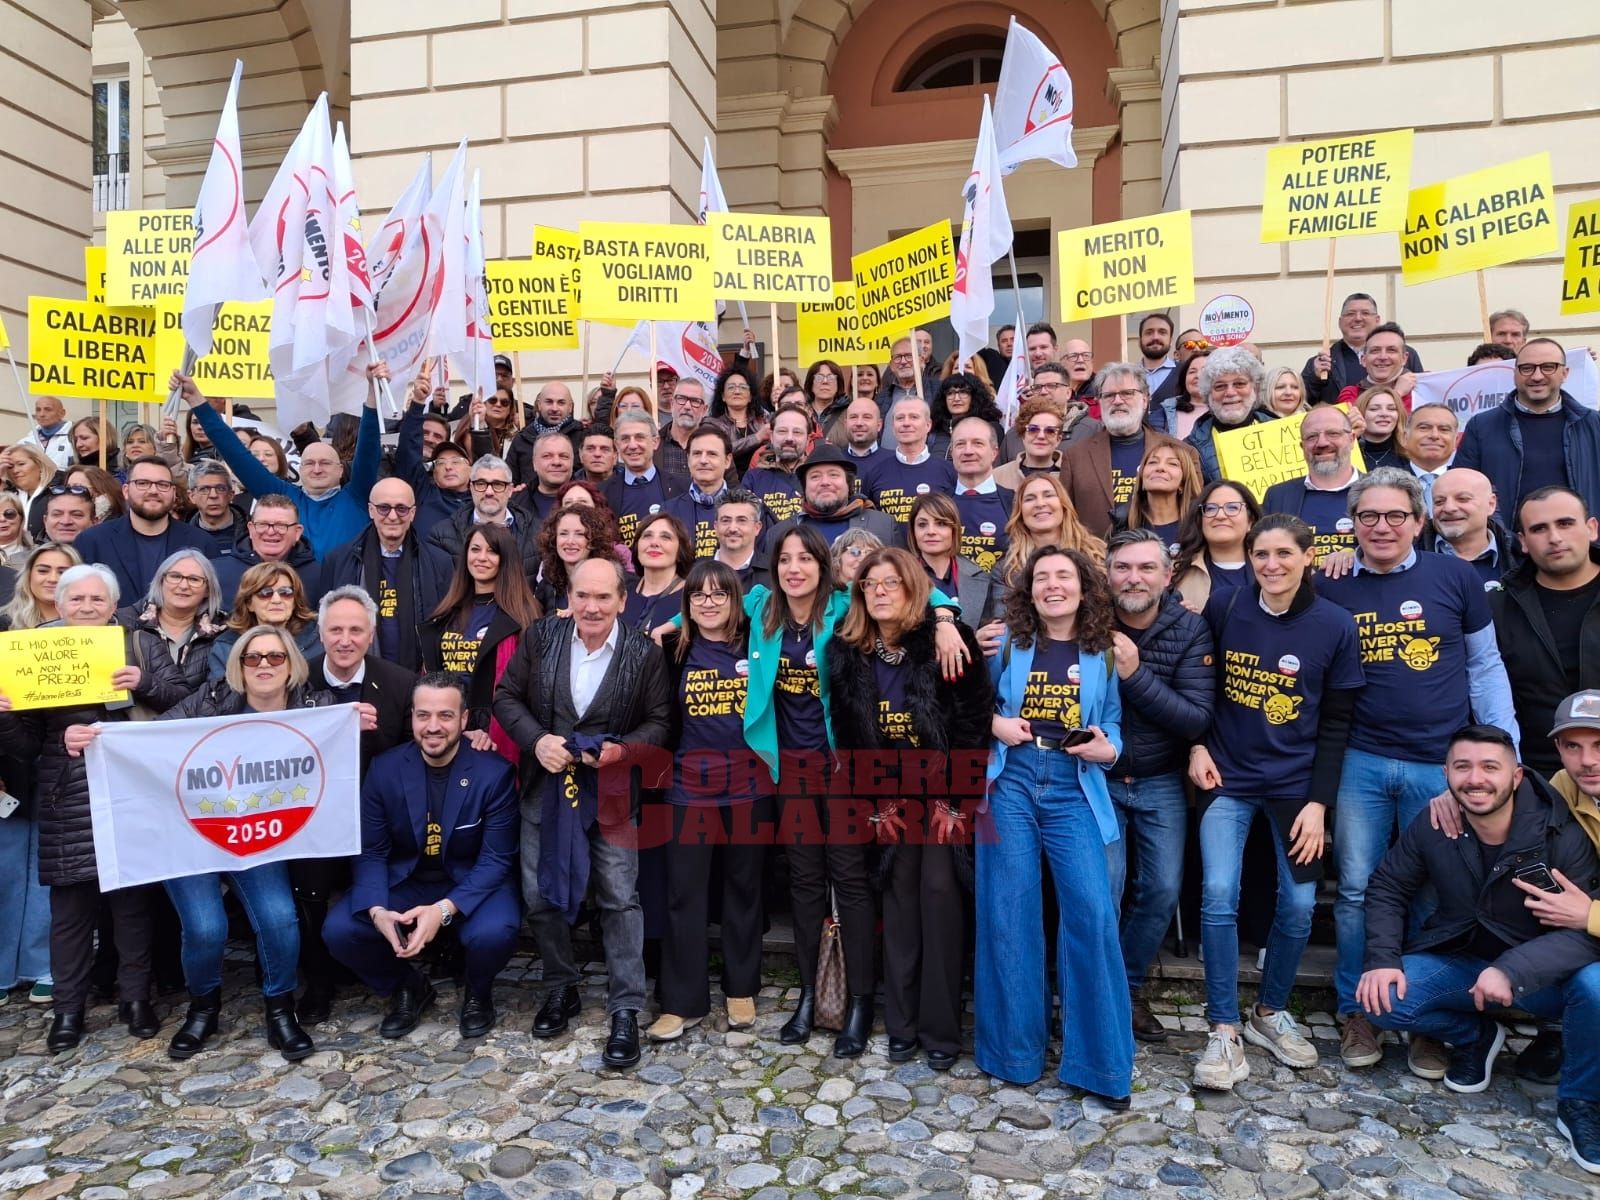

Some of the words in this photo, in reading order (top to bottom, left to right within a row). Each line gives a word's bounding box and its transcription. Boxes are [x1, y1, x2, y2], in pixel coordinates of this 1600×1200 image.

[1301, 140, 1376, 165] POTERE
[1282, 169, 1328, 190] ALLE
[1333, 162, 1391, 183] URNE,
[1288, 192, 1328, 212] NON
[1334, 186, 1382, 208] ALLE
[1404, 213, 1429, 236] LA
[1434, 183, 1545, 227] CALABRIA
[139, 214, 197, 231] POTER
[1288, 211, 1378, 235] FAMIGLIE
[722, 223, 816, 244] CALABRIA
[1404, 233, 1449, 259] NON
[1455, 226, 1475, 246] SI
[1482, 207, 1550, 241] PIEGA
[122, 238, 163, 255] ALLE
[583, 239, 640, 258] BASTA
[644, 241, 710, 262] FAVORI,
[1084, 227, 1164, 257] MERITO,
[737, 248, 804, 268] LIBERA
[856, 271, 868, 288] IL
[870, 257, 905, 282] VOTO
[907, 243, 937, 269] NON
[941, 236, 951, 256] È
[130, 261, 166, 277] NON
[171, 260, 189, 275] AL
[602, 262, 693, 282] VOGLIAMO
[1103, 255, 1147, 279] NON
[486, 278, 514, 294] OTO
[519, 277, 555, 294] NON
[560, 273, 570, 293] È
[713, 272, 747, 290] DAL
[753, 274, 831, 293] RICATTO
[862, 286, 890, 308] UNA
[893, 262, 949, 296] GENTILE
[1562, 276, 1590, 301] LA
[618, 286, 678, 304] DIRITTI
[1076, 276, 1177, 308] COGNOME
[498, 299, 567, 316] GENTILE
[801, 296, 855, 313] DEMOC
[861, 283, 954, 330] CONCESSIONE
[837, 316, 859, 331] NO
[1205, 309, 1249, 322] MOVIMENTO
[491, 321, 574, 338] CESSIONE
[64, 338, 146, 364] LIBERA
[209, 338, 251, 356] NON
[30, 362, 75, 385] DAL
[83, 367, 155, 391] RICAT
[1448, 389, 1509, 413] MOVIME
[763, 491, 787, 500] FATTI
[879, 488, 904, 496] FATTI
[879, 499, 898, 508] NON
[619, 513, 637, 524] ATTI
[620, 523, 634, 533] ON
[961, 535, 996, 546] FOSTE
[1314, 534, 1355, 545] FOSTE
[1354, 611, 1377, 624] TTI
[1374, 619, 1426, 635] FOSTE
[9, 640, 24, 651] IL
[29, 640, 48, 650] MIO
[53, 636, 76, 647] VOTO
[441, 641, 456, 650] ON
[1360, 635, 1398, 651] IVER
[34, 649, 79, 663] VALORE
[1225, 650, 1260, 667] FATTI
[1360, 647, 1394, 664] OME
[16, 666, 33, 677] MA
[40, 664, 61, 674] NON
[72, 662, 90, 671] HA
[687, 668, 719, 681] FATTI
[1028, 671, 1048, 682] TTI
[1225, 662, 1252, 679] NON
[1252, 669, 1297, 688] FOSTE
[685, 681, 714, 693] NON
[717, 677, 748, 690] FOST
[1043, 684, 1080, 696] FOST
[1232, 677, 1267, 696] VIVER
[685, 694, 694, 705] A
[696, 691, 735, 704] VIVER
[1224, 686, 1262, 710] COME
[688, 702, 732, 717] COME
[1021, 707, 1057, 721] OME
[187, 755, 315, 792] MOVIMENTO
[226, 818, 283, 845] 2050
